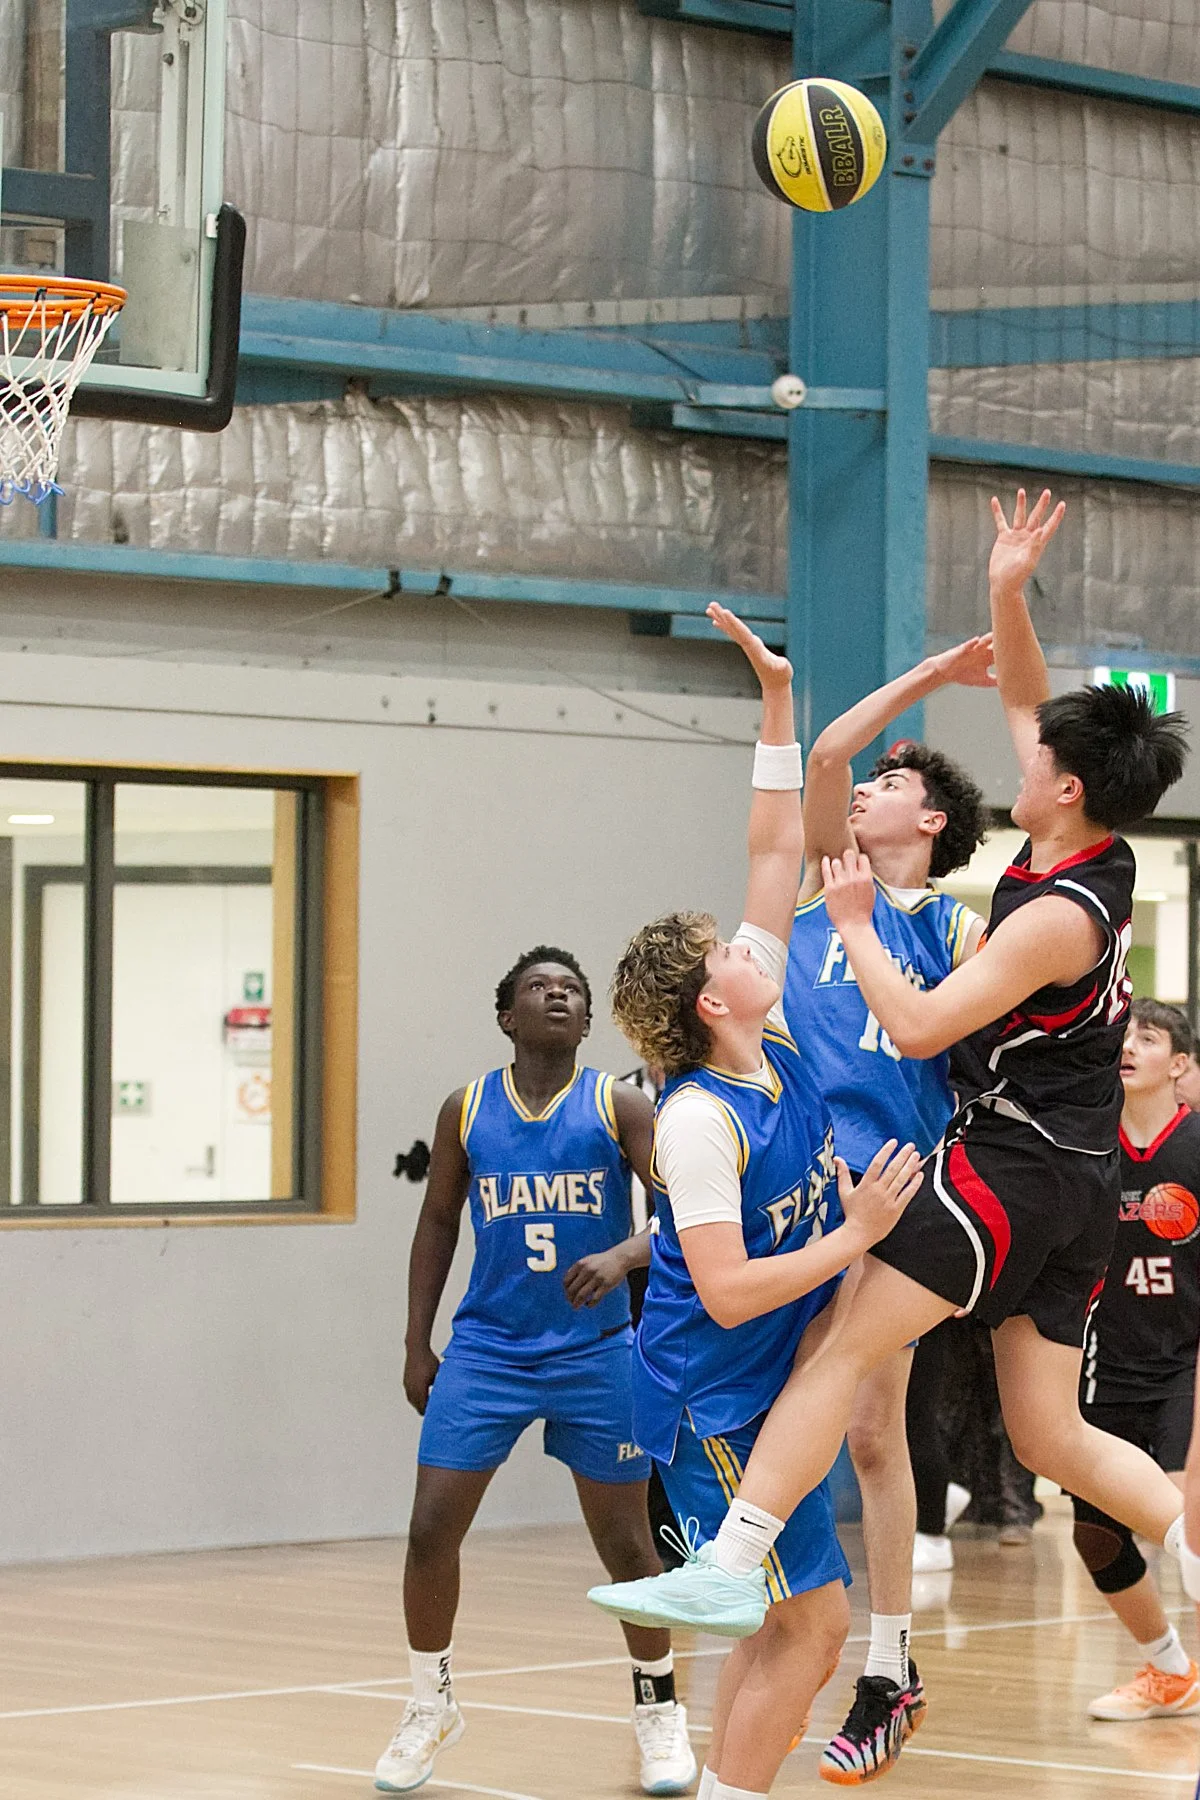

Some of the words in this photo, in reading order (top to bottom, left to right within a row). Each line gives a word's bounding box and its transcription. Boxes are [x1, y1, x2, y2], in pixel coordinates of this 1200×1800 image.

[476, 1169, 607, 1226] FLAMES
[525, 1223, 557, 1272] 5
[1125, 1256, 1174, 1295] 45
